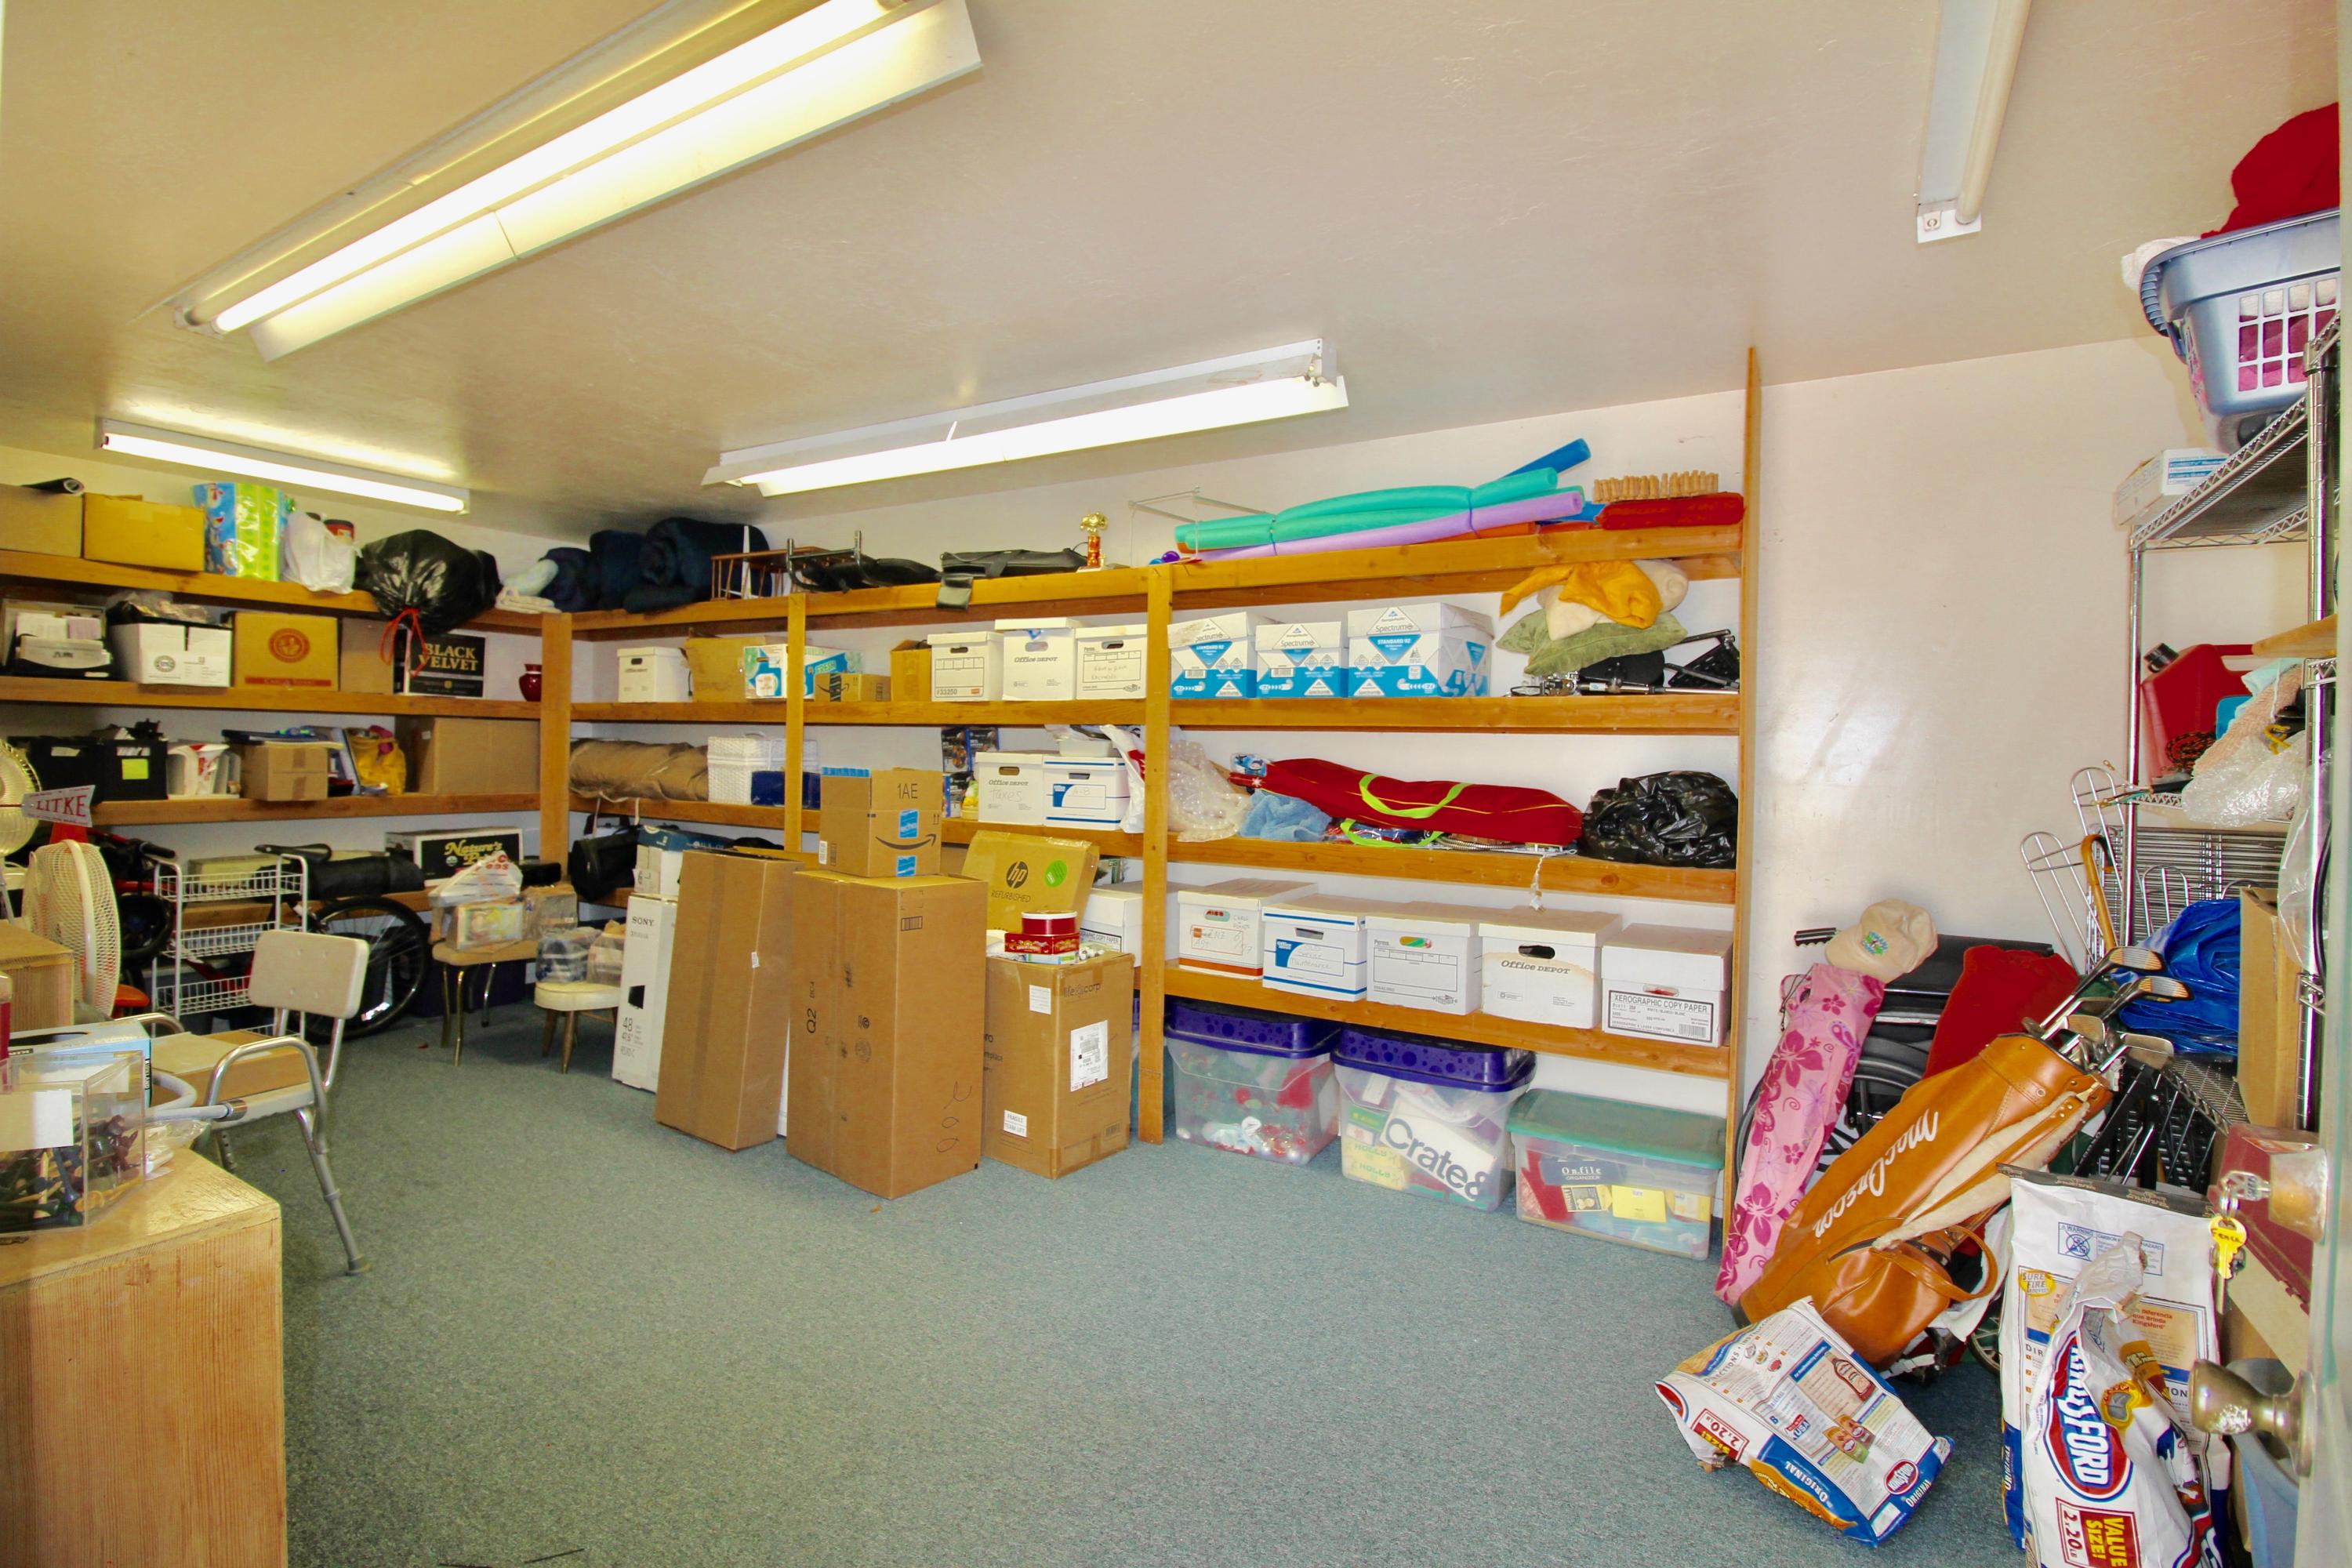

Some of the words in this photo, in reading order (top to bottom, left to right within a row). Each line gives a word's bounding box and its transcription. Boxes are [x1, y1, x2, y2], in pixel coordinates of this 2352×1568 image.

[1375, 623, 1407, 633] Spectrum
[1192, 632, 1219, 643] pectrum
[1281, 639, 1309, 648] Spectrum
[425, 643, 476, 659] BLACK
[418, 654, 479, 671] VELVET
[897, 783, 919, 799] 1AE
[36, 795, 88, 817] LITKE
[444, 839, 503, 857] Nature's
[1007, 861, 1029, 889] hp
[991, 890, 1032, 903] REFURBISHED
[632, 916, 655, 927] SONY
[1501, 960, 1536, 971] Office
[1537, 965, 1571, 975] DEPOT
[1614, 994, 1663, 1007] XEROGRAPHIC
[1664, 1000, 1683, 1009] COPY
[1684, 1004, 1708, 1013] PAPER
[622, 1017, 633, 1032] 48
[807, 1008, 817, 1033] Q2
[1813, 1109, 1939, 1238] MacGregor
[2067, 1225, 2093, 1236] WARNING
[2022, 1272, 2045, 1281] SURE
[2027, 1280, 2045, 1289] FIRE
[2141, 1308, 2172, 1319] Diferencia
[1794, 1421, 1809, 1437] USA
[1785, 1461, 1828, 1502] ORIGINAL
[1905, 1479, 1933, 1508] ORIGINAL
[2085, 1519, 2107, 1560] SIZE!
[2103, 1517, 2128, 1567] VALUE
